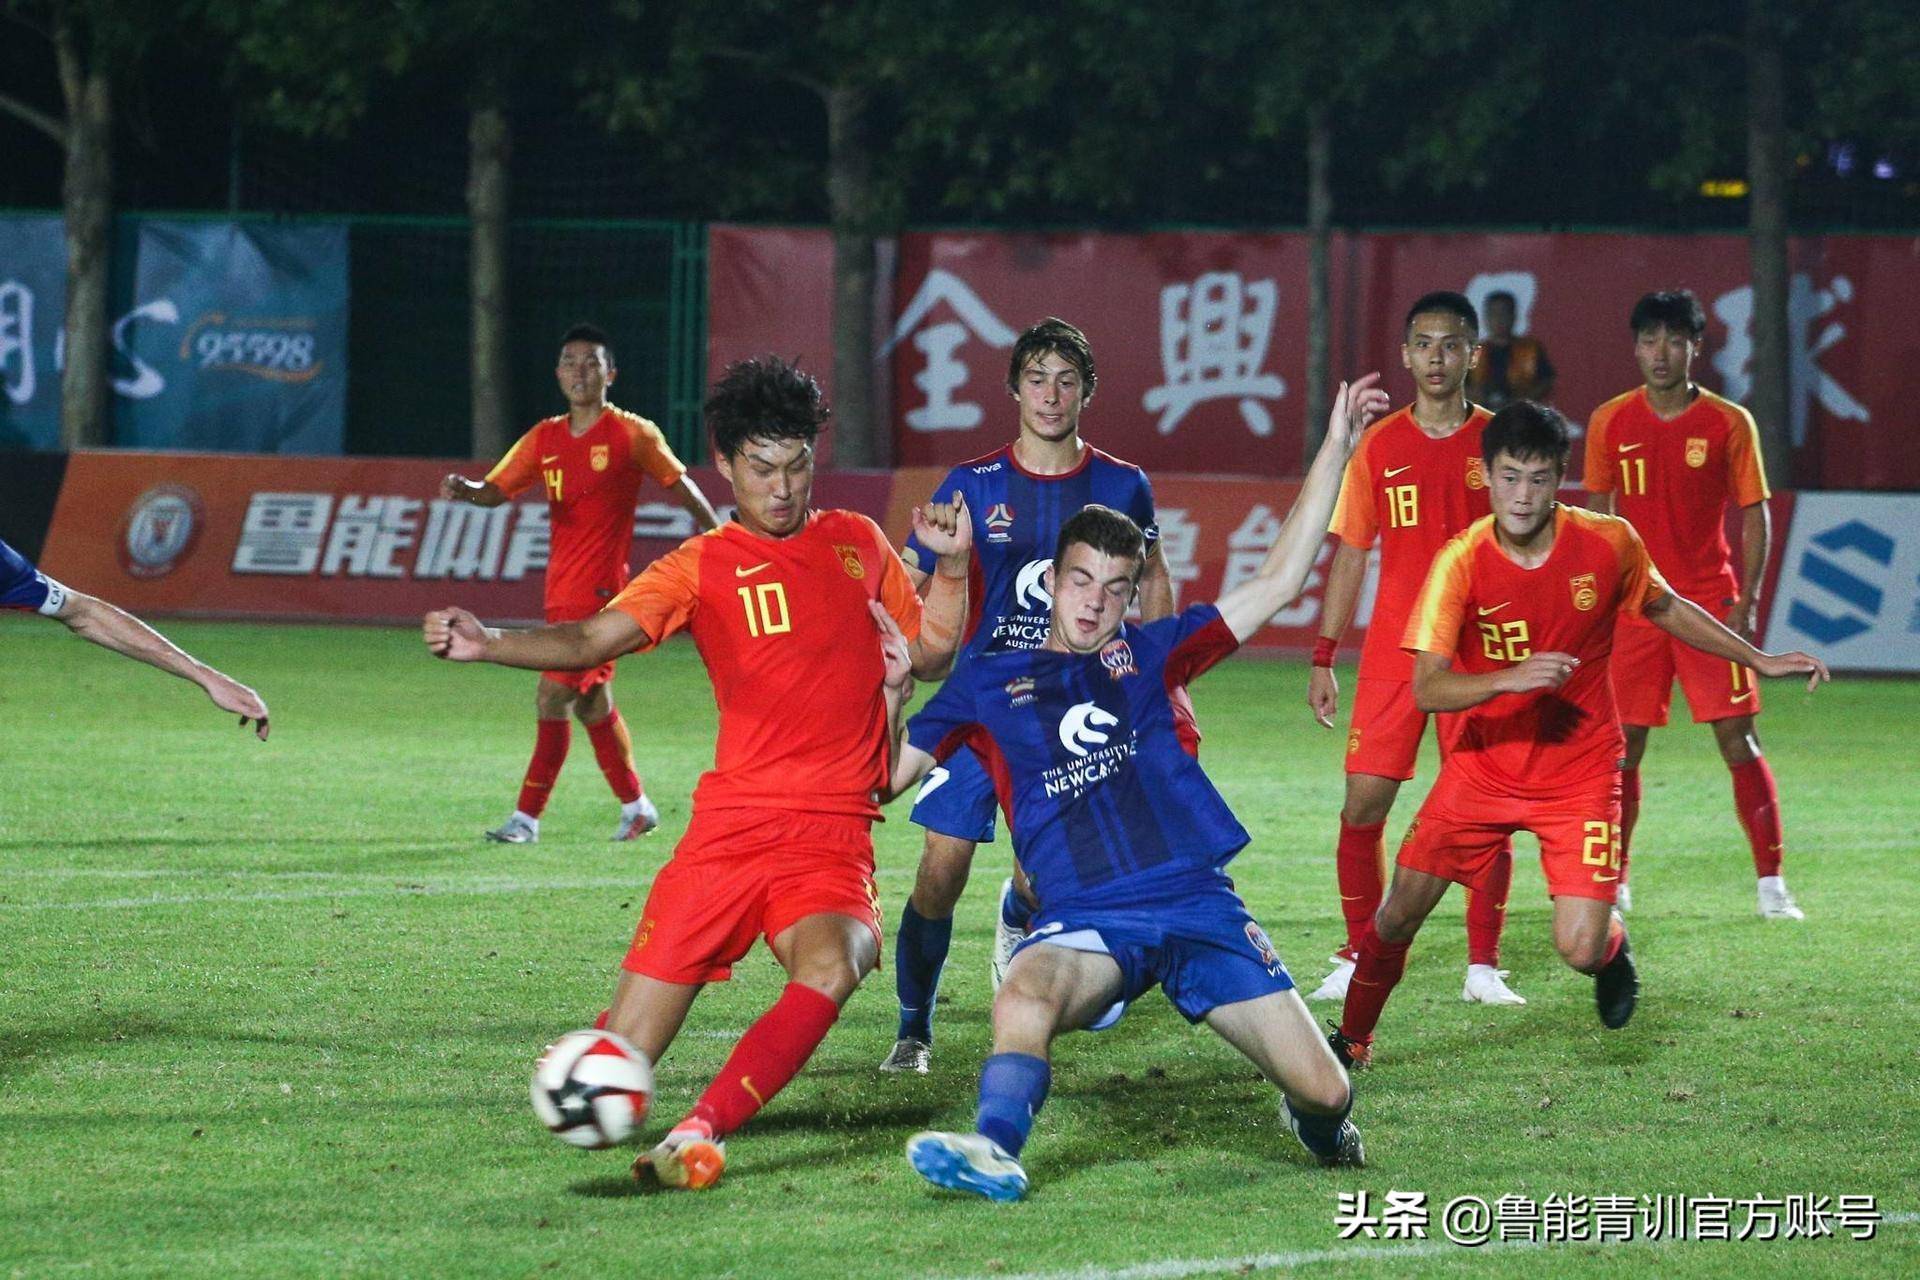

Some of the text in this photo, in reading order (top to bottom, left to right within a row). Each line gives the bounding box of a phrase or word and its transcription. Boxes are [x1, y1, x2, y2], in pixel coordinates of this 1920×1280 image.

[1618, 457, 1647, 496] 11
[1384, 483, 1419, 529] 18
[737, 582, 791, 638] 10
[1477, 619, 1531, 662] 22
